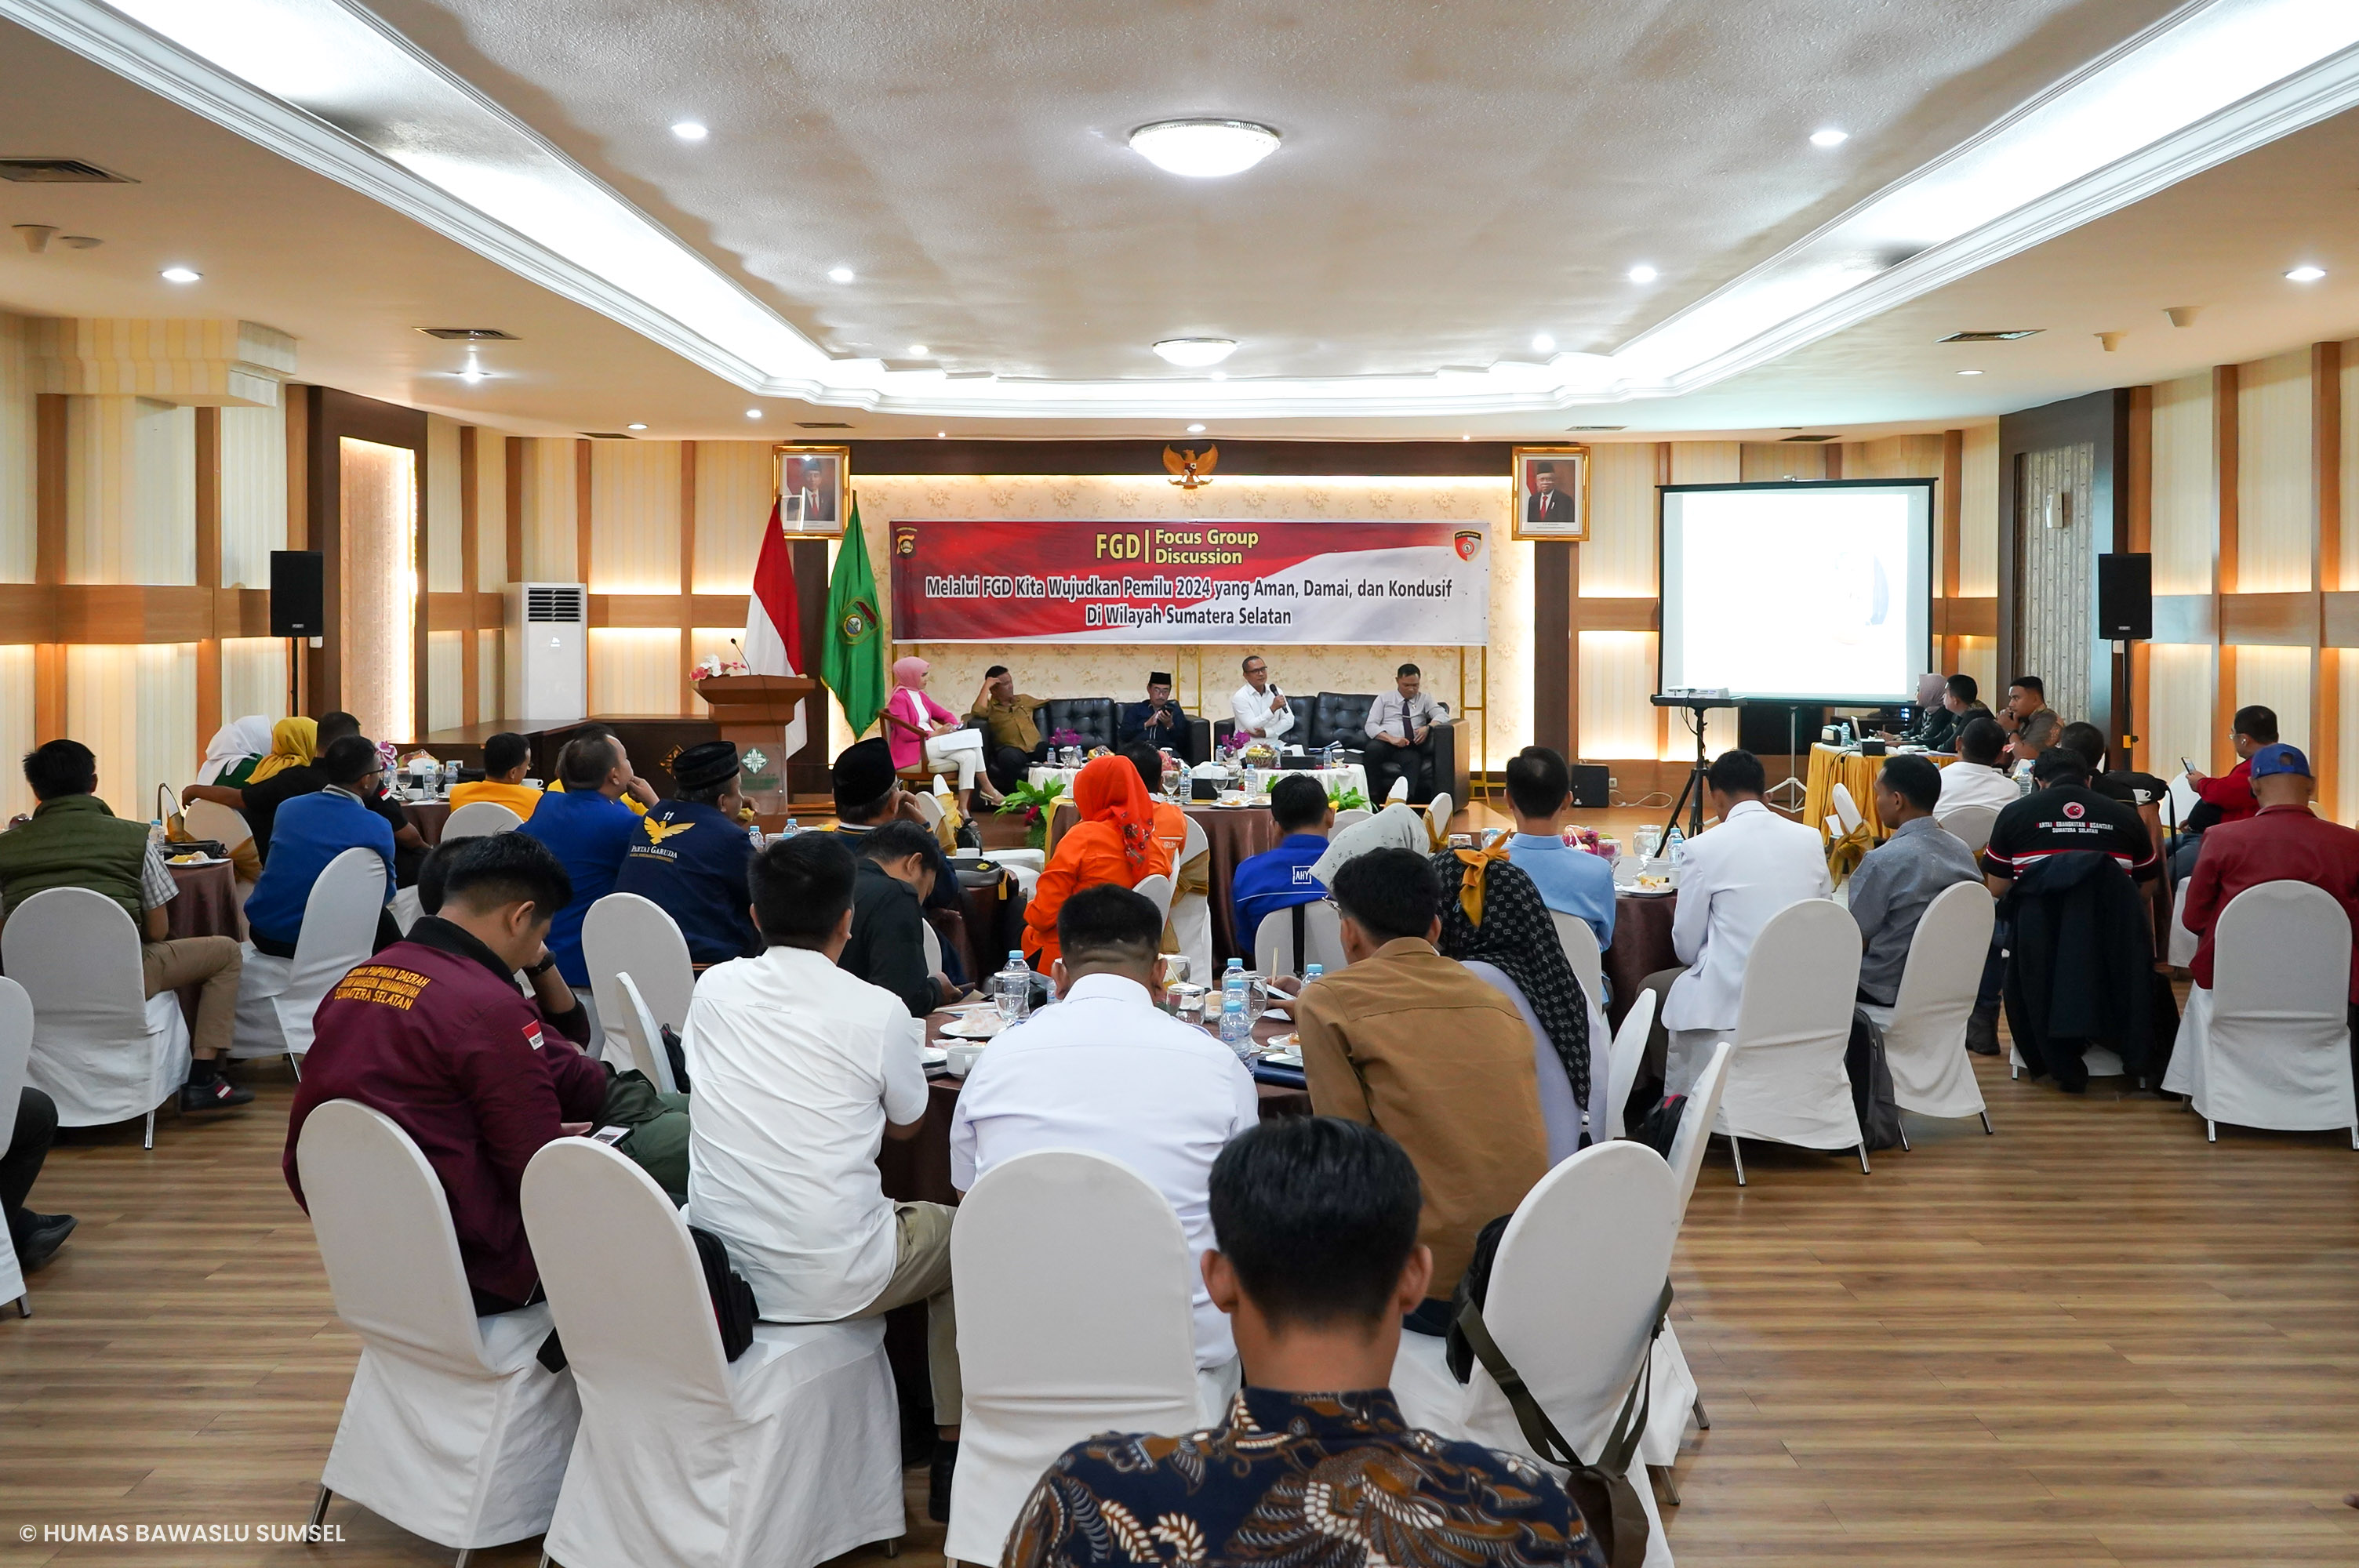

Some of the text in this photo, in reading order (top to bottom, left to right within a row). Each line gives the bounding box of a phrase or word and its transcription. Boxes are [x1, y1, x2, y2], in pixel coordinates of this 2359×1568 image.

[1096, 529, 1259, 560] FGD Focus Group
[1155, 548, 1243, 564] Discussion
[926, 577, 1452, 601] Melalui FGD Kita Wujudkan Pemilu 2024 yang Aman, Damai, dan Kondusif
[1087, 605, 1292, 628] Di Wilayah Sumatera Selatan
[663, 811, 674, 821] 11
[651, 845, 678, 858] GARUDA
[1295, 870, 1310, 881] AHY
[394, 970, 431, 988] DAERAH
[372, 989, 414, 1011] SELATAN
